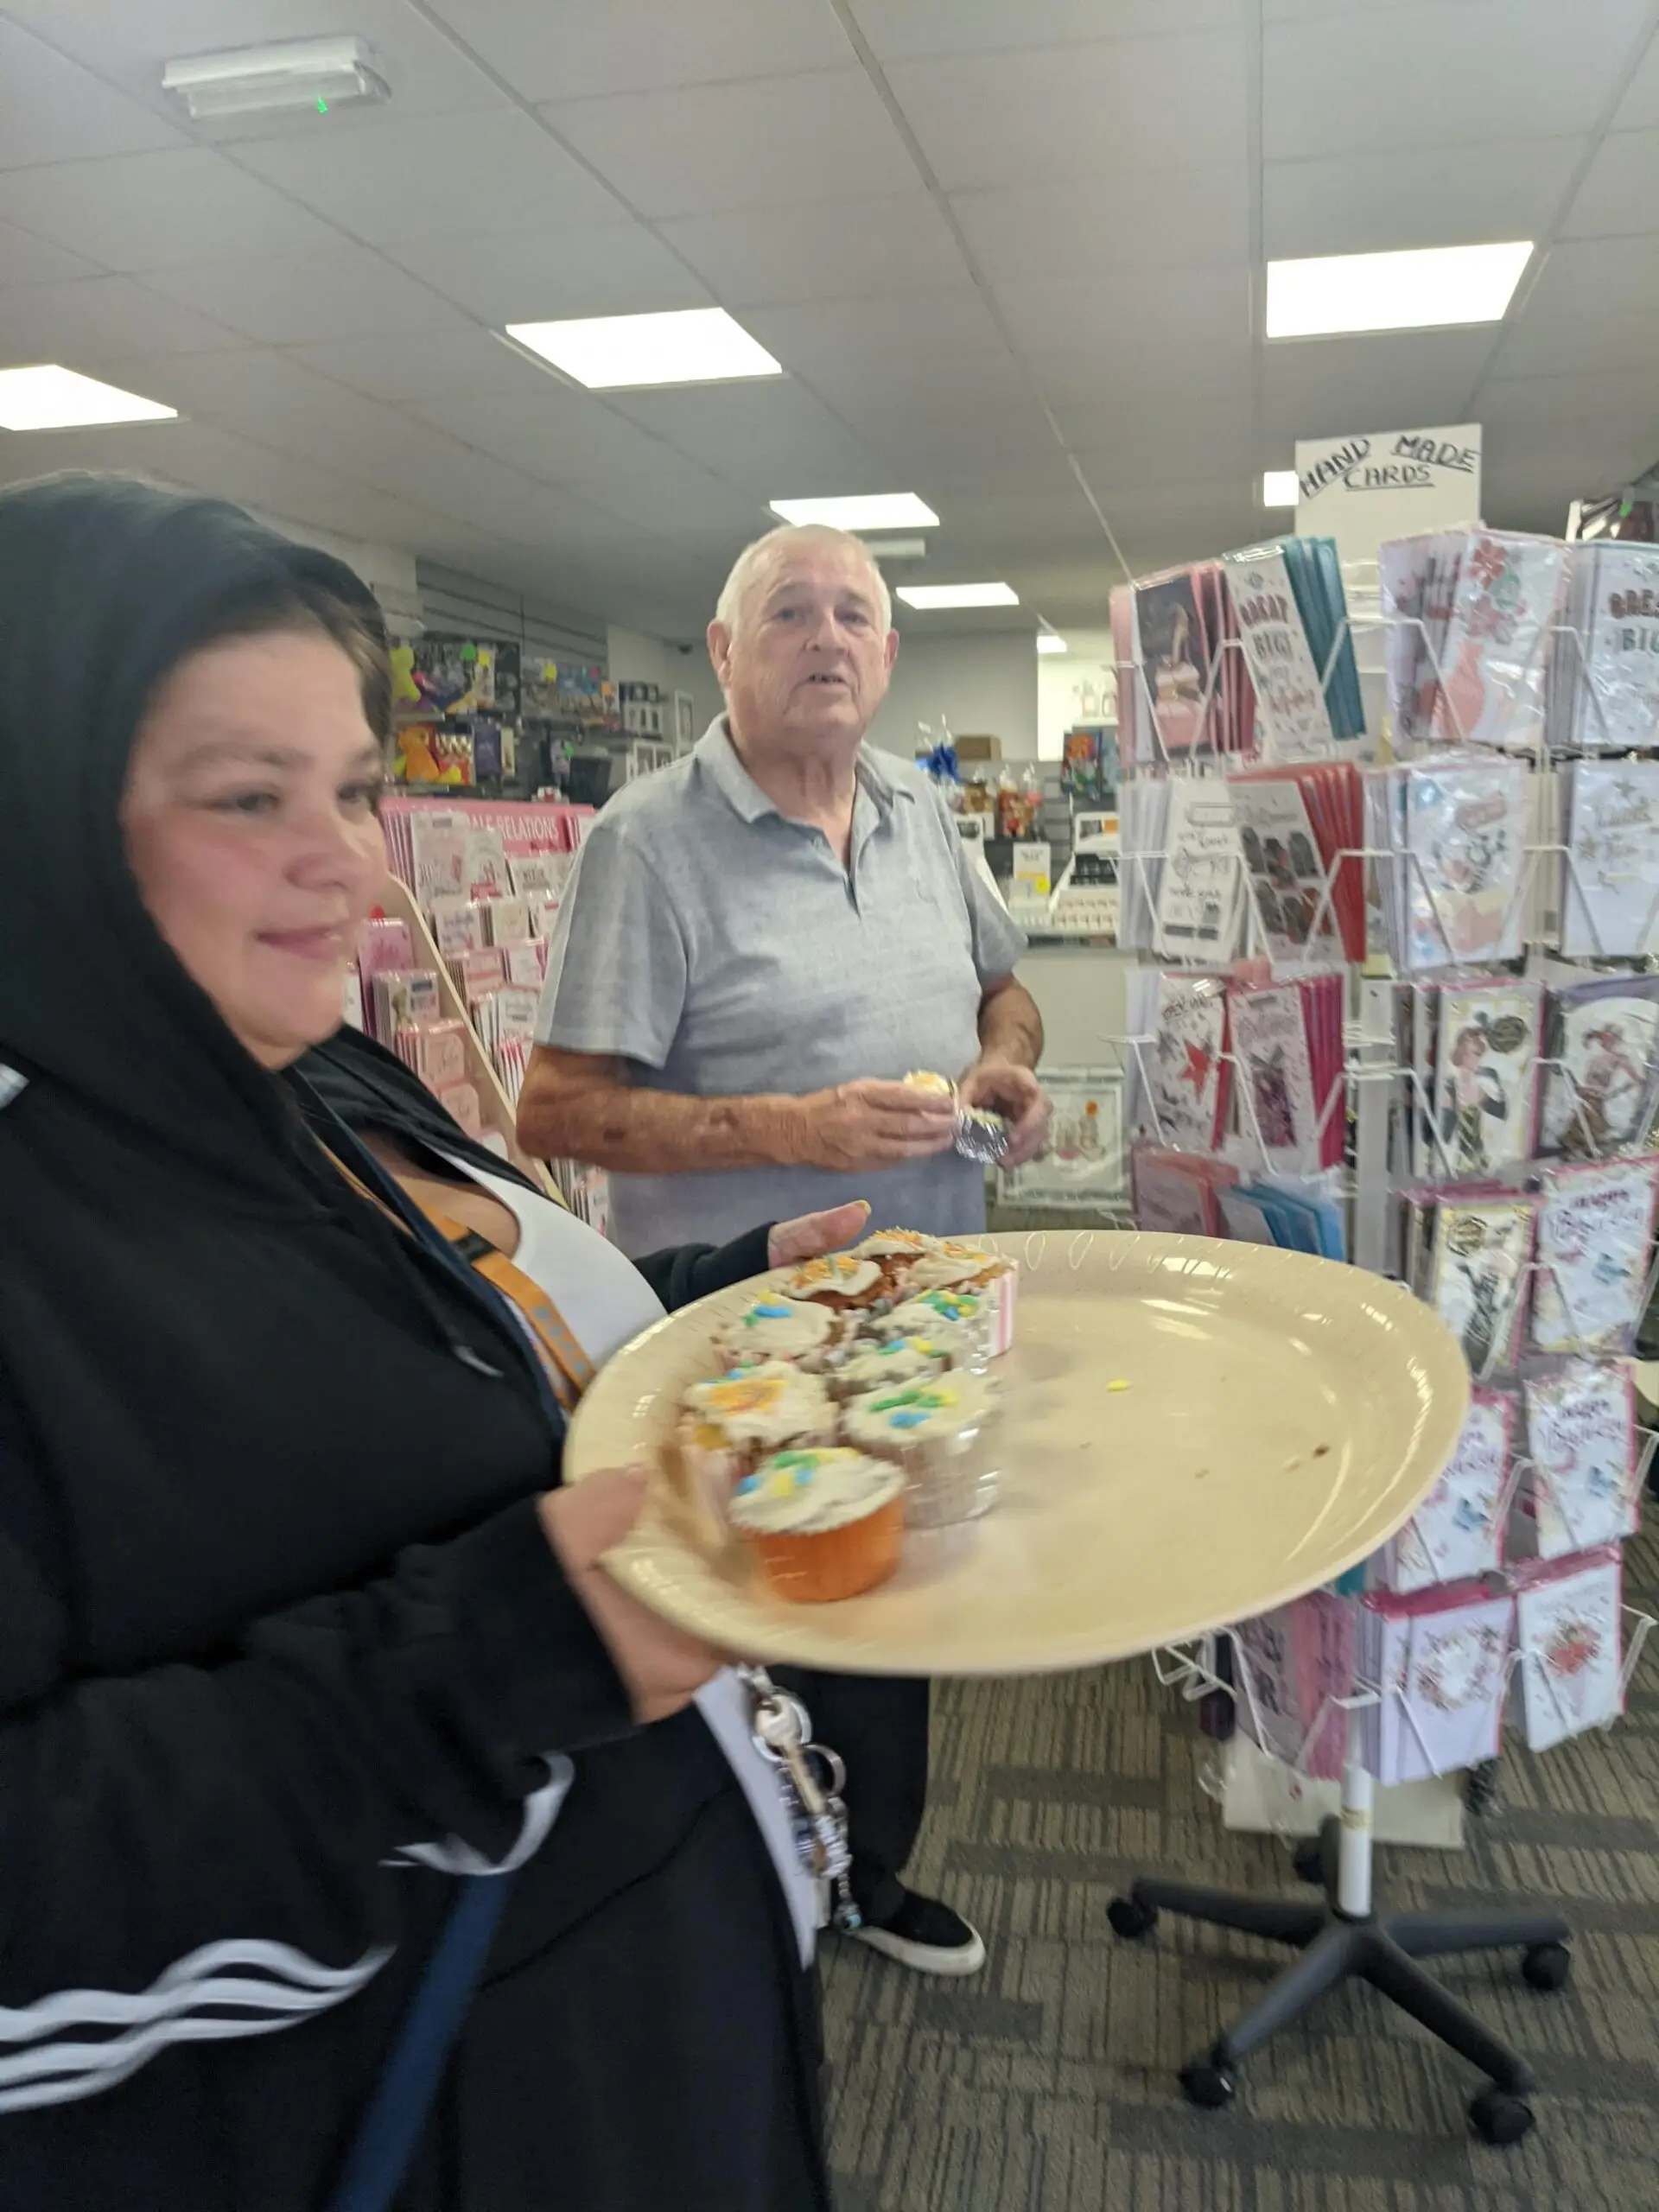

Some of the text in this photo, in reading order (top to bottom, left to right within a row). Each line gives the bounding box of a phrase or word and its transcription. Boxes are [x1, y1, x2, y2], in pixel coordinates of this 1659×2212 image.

[1299, 435, 1481, 499] HAND MADE
[1342, 463, 1432, 489] CARDS
[496, 814, 559, 841] RELATIONS
